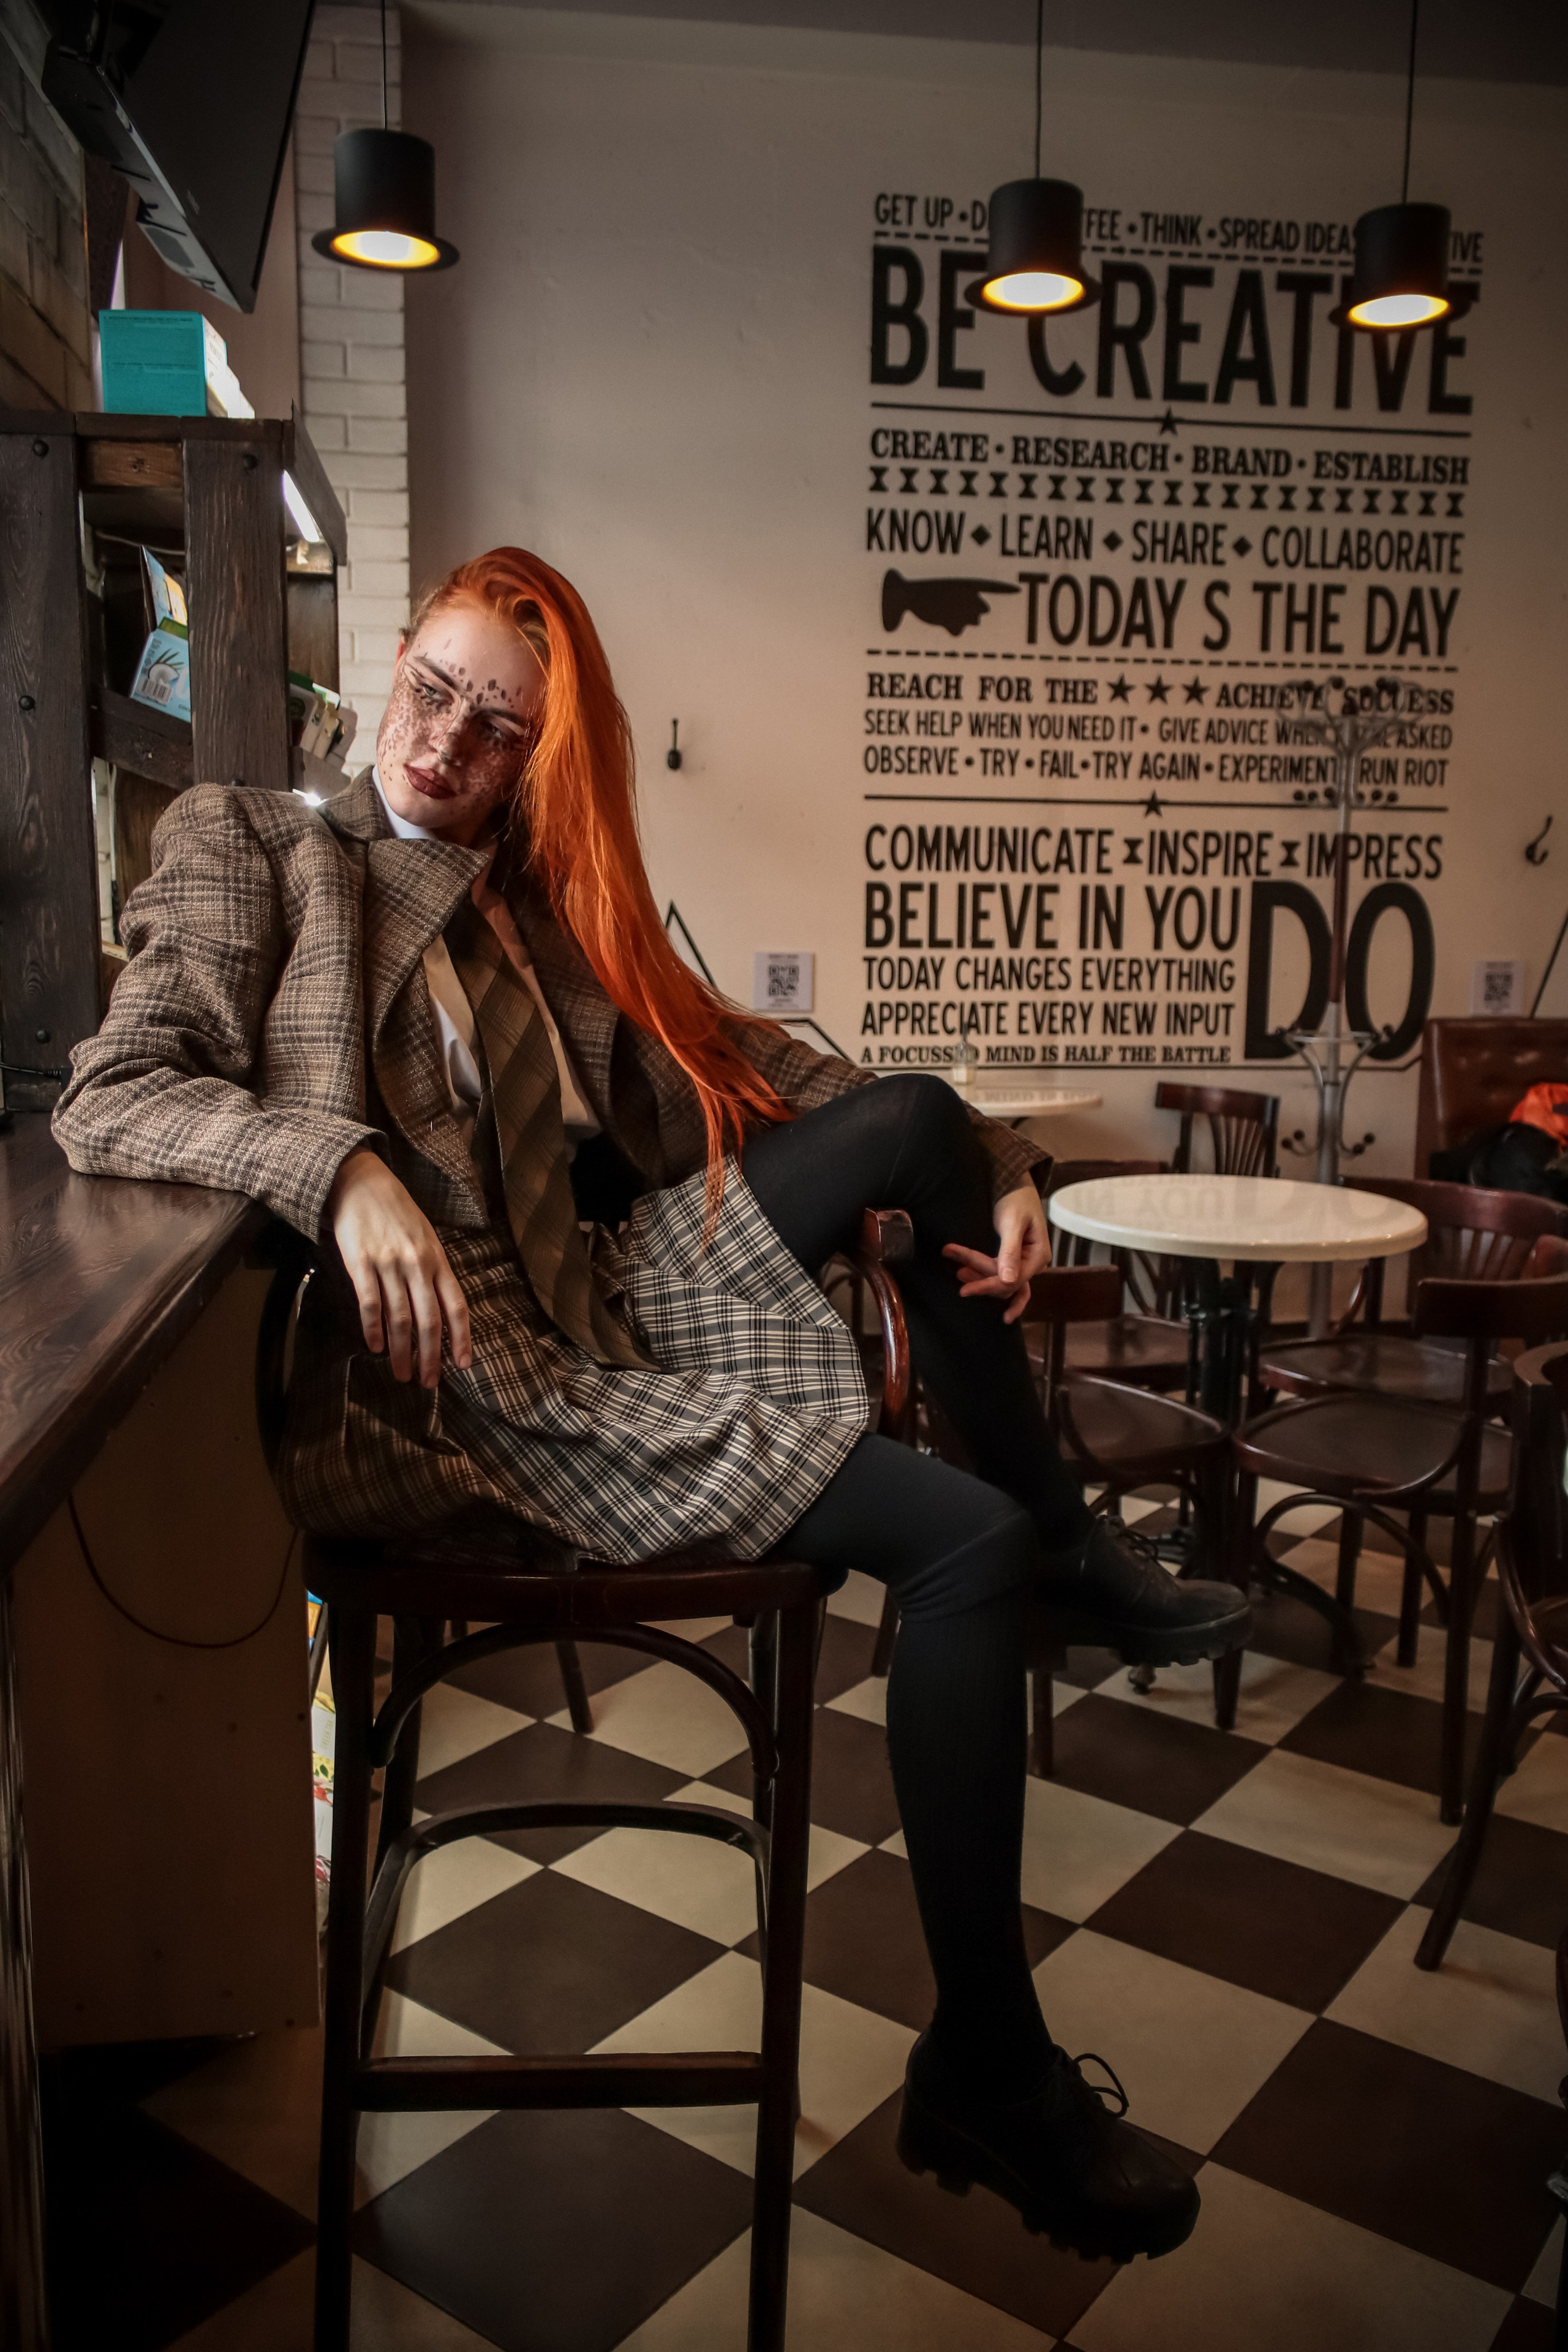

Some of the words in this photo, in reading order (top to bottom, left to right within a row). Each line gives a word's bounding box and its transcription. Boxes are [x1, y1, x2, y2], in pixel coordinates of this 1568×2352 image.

[874, 192, 918, 227] GET
[924, 197, 954, 228] UP
[1140, 211, 1202, 246] THINK
[1219, 217, 1300, 252] SPREAD
[1305, 222, 1355, 255] IDEA
[870, 244, 986, 390] BE
[870, 428, 989, 463] CREATE
[1011, 435, 1170, 472] RESEARCH
[1191, 445, 1292, 478] BRAND
[1313, 450, 1470, 486] ESTABLISH
[866, 508, 966, 555] KNOW
[1000, 513, 1093, 560] LEARN
[1132, 519, 1227, 567] SHARE
[1262, 525, 1464, 575] COLLABORATE
[1017, 571, 1187, 650] TODAY
[1252, 581, 1347, 655] THE
[1364, 584, 1461, 658] DAY
[867, 673, 963, 700] REACH
[978, 676, 1033, 703] FOR
[1044, 677, 1098, 705] THE
[1215, 681, 1325, 710] ACHIEVE
[864, 709, 910, 736] SEEK
[916, 710, 962, 737] HELP
[968, 712, 1022, 739] WHEN
[1028, 714, 1064, 740] YOU
[1069, 715, 1115, 741] NEED
[1120, 717, 1137, 741] IT
[1158, 717, 1200, 744] GIVE
[1204, 718, 1268, 745] ADVICE
[1395, 723, 1453, 750] ASKED
[864, 745, 959, 775] OBSERVE
[979, 748, 1020, 777] TRY
[1039, 749, 1079, 778] FAIL
[1093, 751, 1133, 780] TRY
[1138, 752, 1200, 781] AGAIN
[1219, 755, 1338, 784] EXPERIMENT
[1359, 757, 1399, 786] RUN
[1404, 758, 1449, 787] RIOT
[865, 824, 1114, 875] COMMUNICATE
[1148, 830, 1274, 876] INSPIRE
[1306, 833, 1443, 880] IMPRESS
[865, 881, 1060, 951] BELIEVE
[1079, 884, 1125, 951] IN
[1144, 885, 1241, 952] YOU
[862, 956, 945, 990] TODAY
[955, 956, 1071, 992] CHANGES
[1081, 957, 1235, 993] EVERYTHING
[1245, 880, 1436, 1061] DO
[861, 1001, 1009, 1037] APPRECIATE
[1017, 1001, 1094, 1036] EVERY
[1102, 1001, 1158, 1036] NEW
[1166, 1002, 1235, 1036] INPUT
[861, 1047, 873, 1063] A
[986, 1046, 1038, 1065] MIND
[1041, 1044, 1060, 1065] IS
[1064, 1046, 1113, 1065] HALF
[1118, 1046, 1156, 1063] THE
[1161, 1046, 1232, 1066] BATTLE
